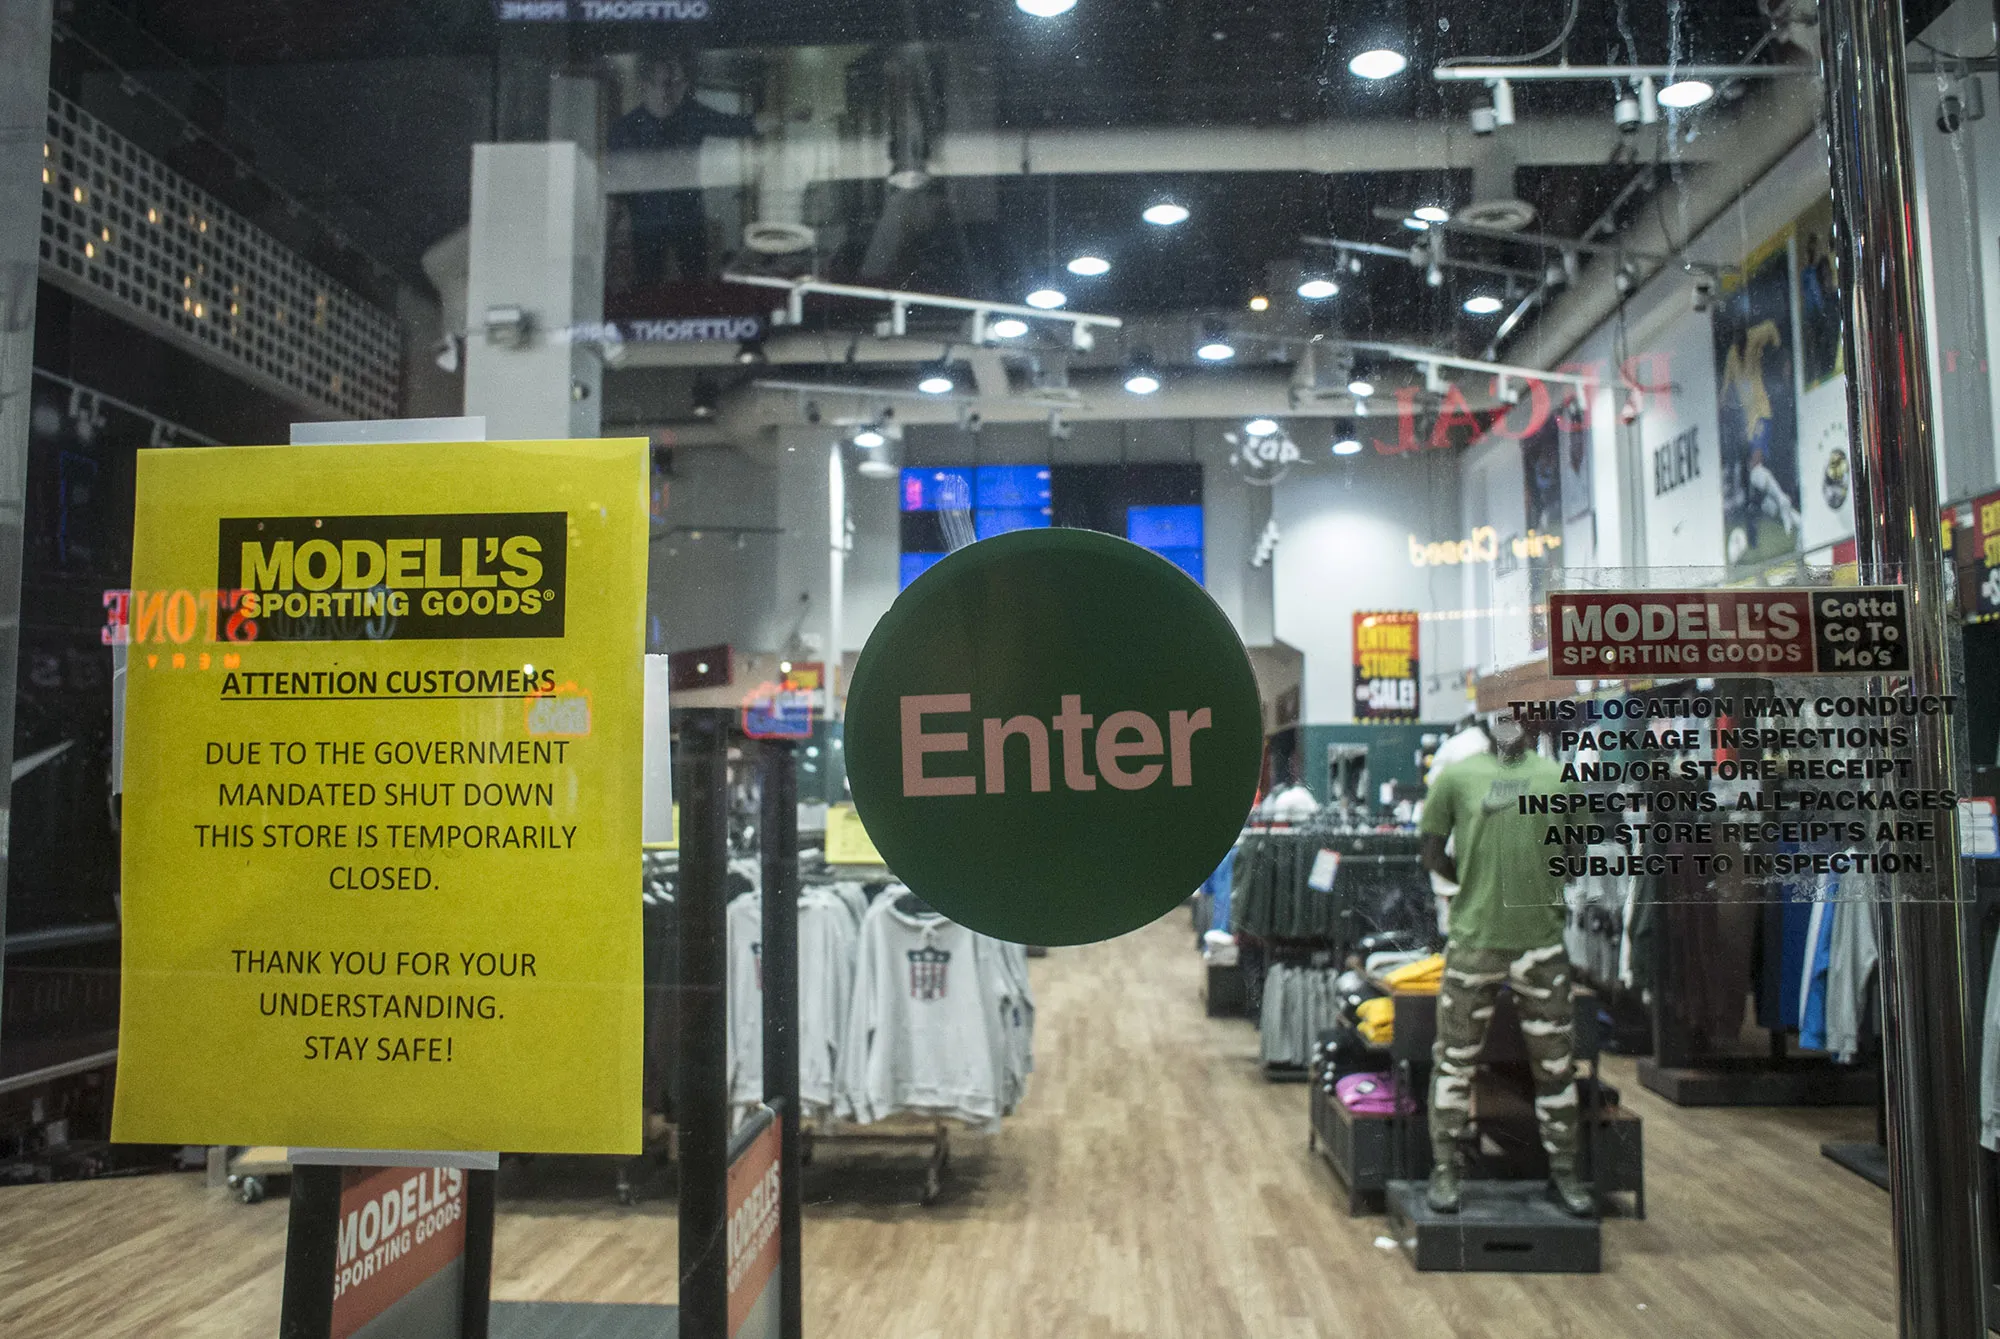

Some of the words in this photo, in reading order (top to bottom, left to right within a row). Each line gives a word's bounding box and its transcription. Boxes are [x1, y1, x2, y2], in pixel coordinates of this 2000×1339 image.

[240, 535, 543, 591] MODELL'S
[240, 590, 409, 618] SPORTING
[1820, 598, 1897, 618] Gotta
[1561, 602, 1799, 642] MODELL'S
[1823, 622, 1861, 642] Go
[1866, 622, 1899, 641] To
[1563, 644, 1699, 665] SPORTING
[1707, 643, 1801, 663] GOODS
[1834, 647, 1893, 667] Mo's
[220, 671, 377, 695] ATTENTION
[386, 669, 555, 694] CUSTOMERS
[1508, 700, 1576, 721] THIS
[1587, 698, 1733, 720] LOCATION
[1744, 697, 1805, 718] MAY
[1814, 695, 1957, 717] CONDUCT
[900, 693, 1212, 797] Enter
[1561, 730, 1699, 751] PACKAGE
[1710, 727, 1908, 749] INSPECTIONS
[206, 741, 261, 765] DUE
[269, 741, 307, 765] TO
[314, 741, 366, 765] THE
[374, 741, 570, 765] GOVERNMENT
[1560, 761, 1671, 783] AND/OR
[1680, 760, 1778, 781] STORE
[1788, 758, 1912, 780] RECEIPT
[219, 783, 376, 807] MANDATED
[384, 783, 456, 807] SHUT
[464, 783, 553, 807] DOWN
[1518, 791, 1726, 815] INSPECTIONS.
[1735, 791, 1790, 811] ALL
[1800, 789, 1957, 811] PACKAGES
[193, 824, 254, 848] THIS
[262, 824, 348, 848] STORE
[357, 824, 378, 848] IS
[386, 824, 577, 849] TEMPORARILY
[1543, 825, 1605, 846] AND
[1614, 823, 1712, 845] STORE
[1722, 821, 1866, 843] RECEIPTS
[1876, 820, 1934, 842] ARE
[1549, 853, 1684, 877] SUBJECT
[1692, 854, 1733, 875] TO
[1743, 853, 1932, 875] INSPECTION.
[329, 867, 440, 891] CLOSED.
[230, 949, 322, 975] THANK
[329, 951, 386, 976] YOU
[396, 952, 450, 976] FOR
[459, 953, 537, 977] YOUR
[259, 992, 504, 1020] UNDERSTANDING.
[303, 1035, 369, 1061] STAY
[376, 1037, 453, 1062] SAFE!
[415, 1197, 461, 1245] GOODS
